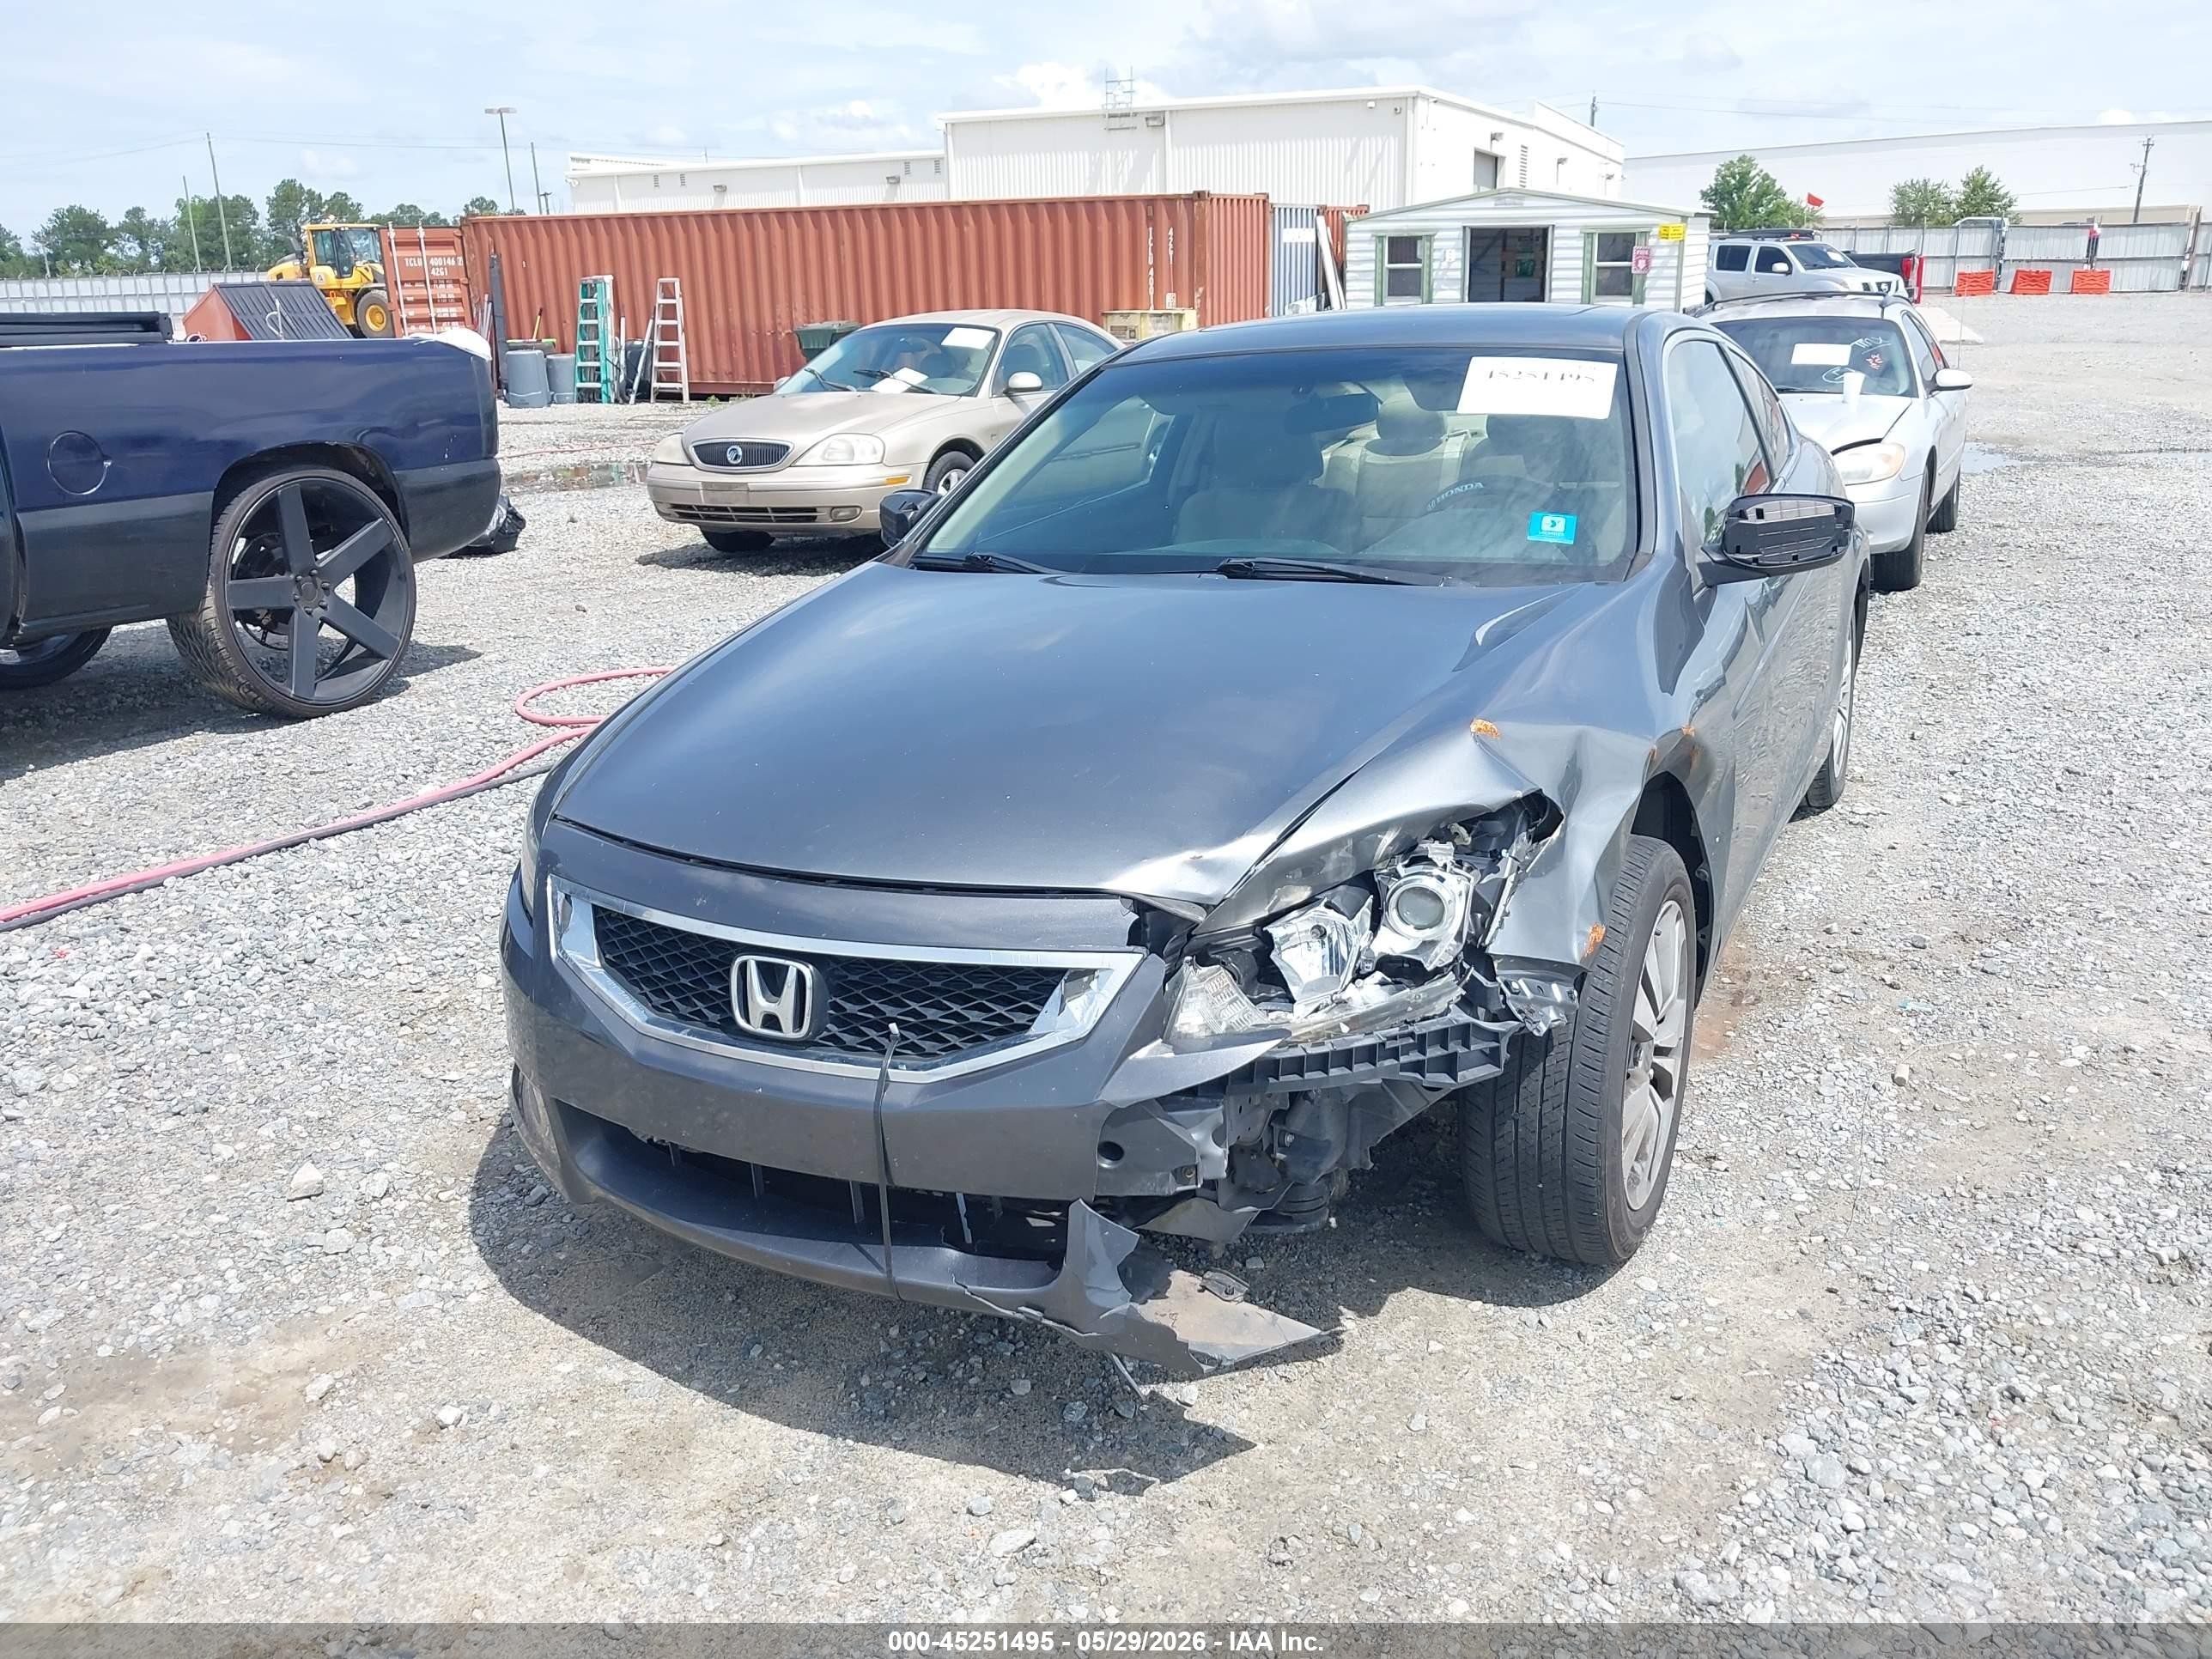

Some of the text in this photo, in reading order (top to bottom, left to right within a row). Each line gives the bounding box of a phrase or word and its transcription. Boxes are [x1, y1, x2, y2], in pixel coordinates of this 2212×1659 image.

[404, 258, 422, 267] TCLU
[429, 257, 456, 266] 400146
[431, 267, 448, 276] 42G1
[1436, 482, 1485, 503] HONDA
